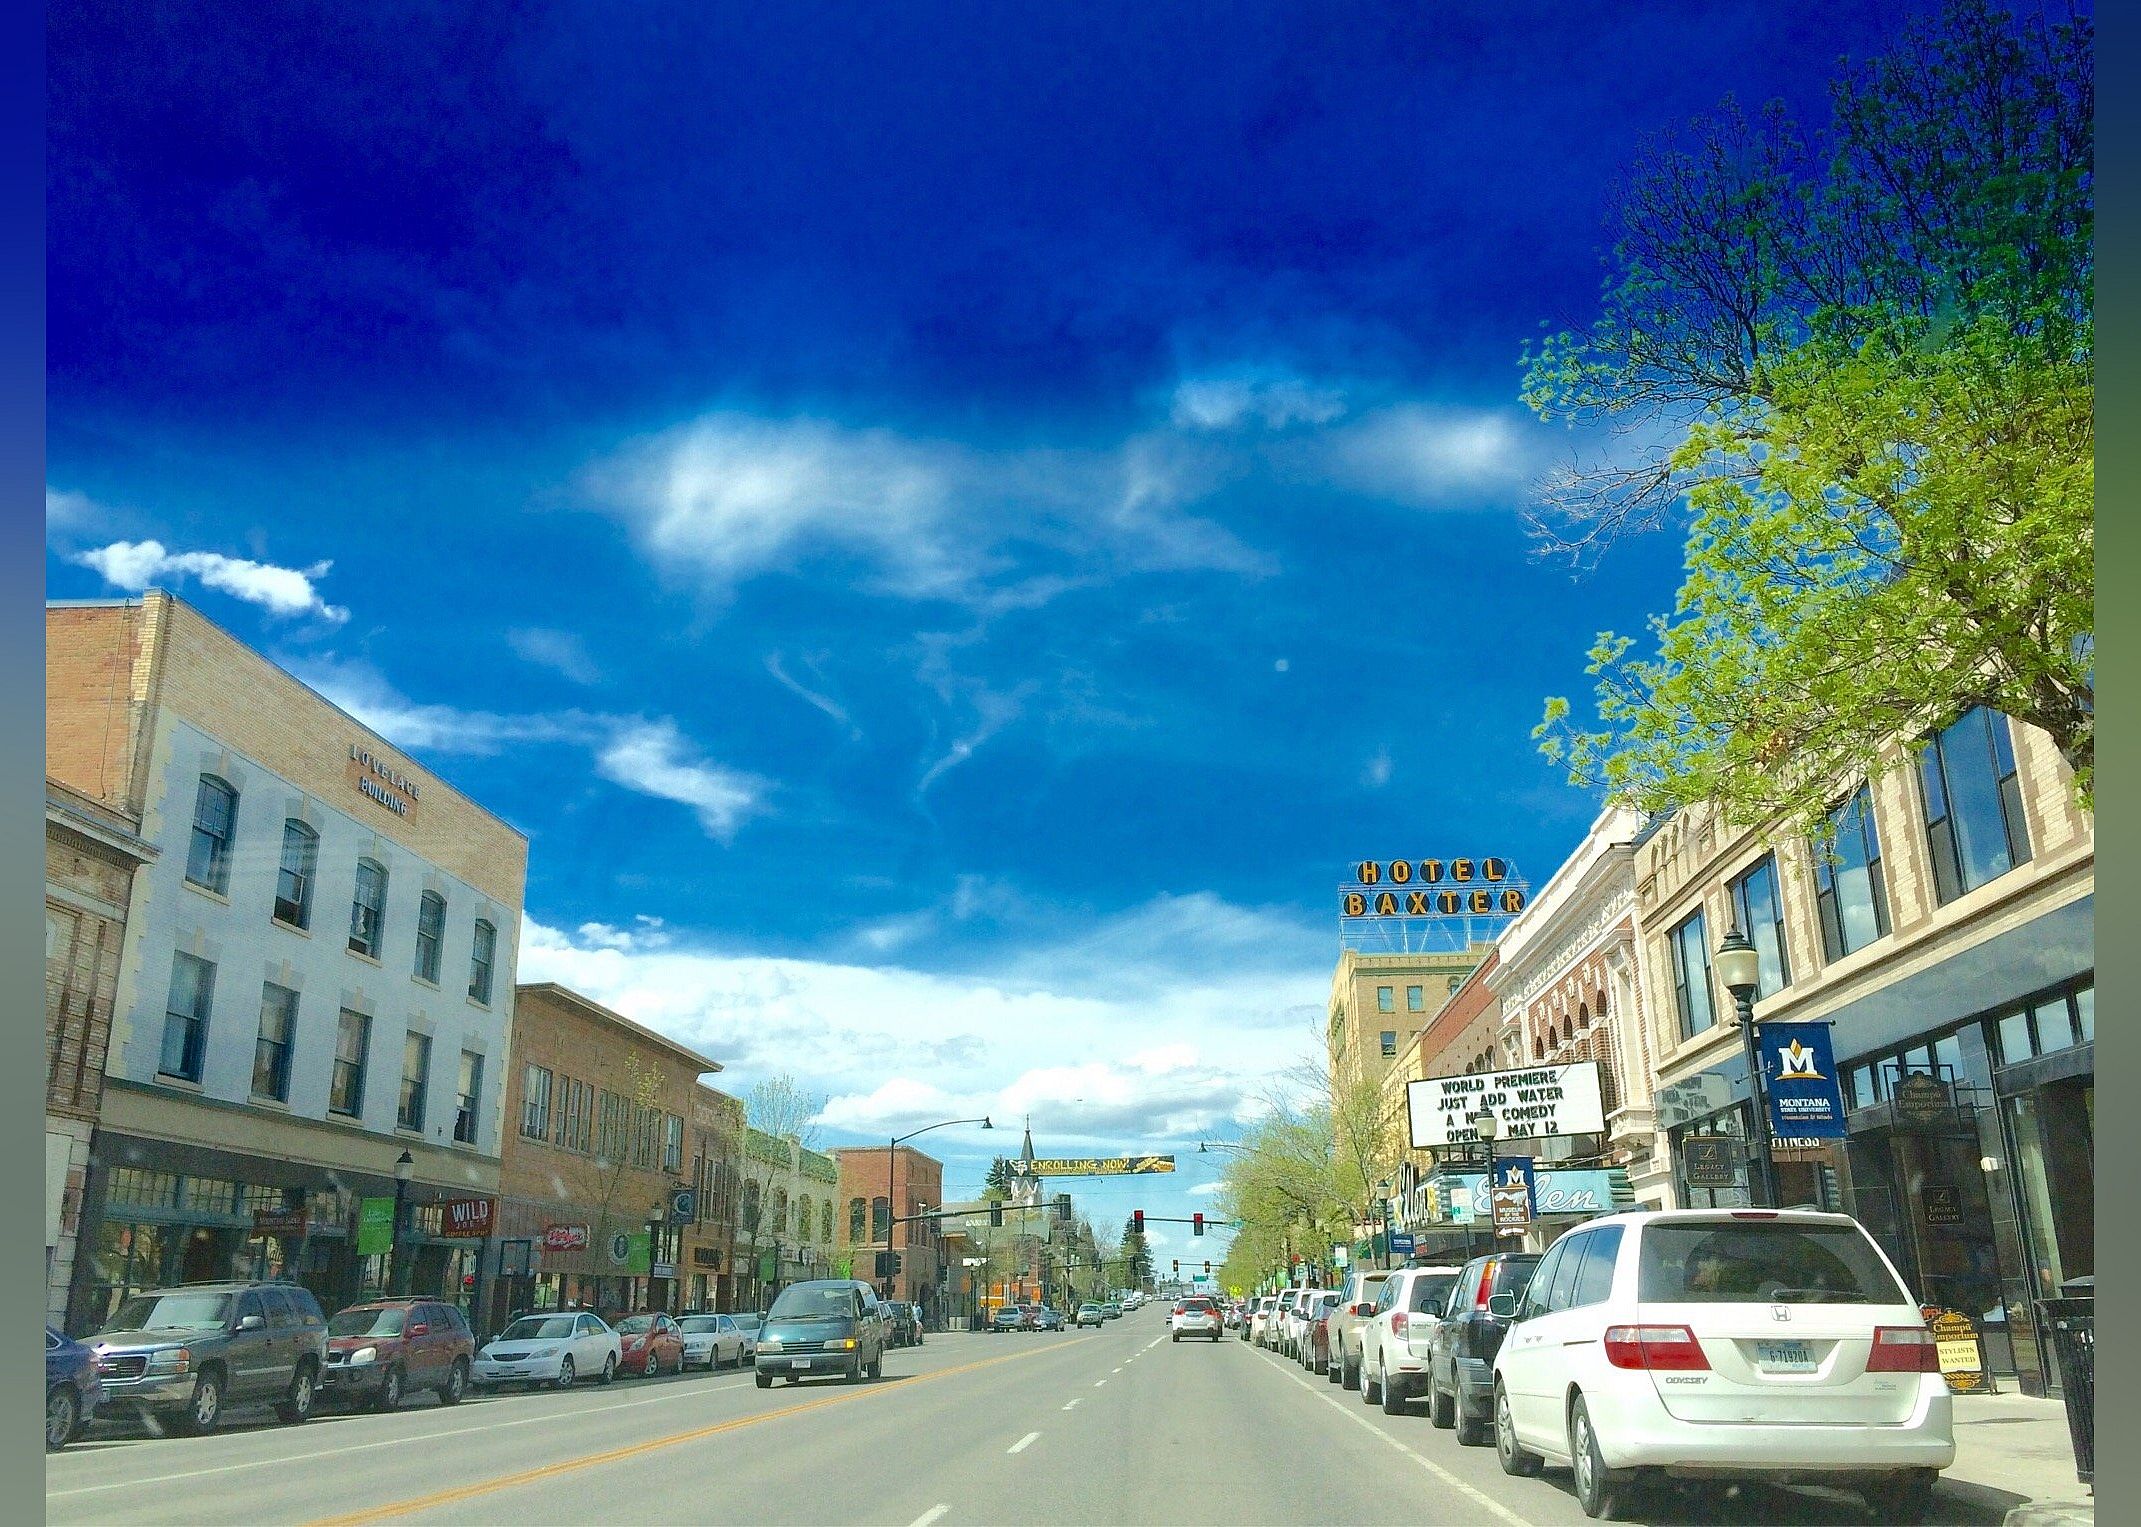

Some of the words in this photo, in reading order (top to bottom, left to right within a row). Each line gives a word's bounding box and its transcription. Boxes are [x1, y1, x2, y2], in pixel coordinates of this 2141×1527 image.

[360, 776, 408, 816] BUILDING
[1362, 858, 1503, 883] HOTEL
[1349, 889, 1521, 915] BAXTER
[1441, 1078, 1485, 1095] WORLD
[1494, 1070, 1558, 1088] PREMIERE
[1437, 1096, 1468, 1112] JUST
[1480, 1092, 1507, 1107] ADD
[1517, 1086, 1565, 1102] WATER
[1779, 1098, 1831, 1107] MONTANA
[1446, 1114, 1455, 1127] A
[1502, 1103, 1557, 1121] COMEDY
[1446, 1127, 1480, 1143] OPEN
[1508, 1121, 1536, 1138] MAY
[1545, 1121, 1559, 1135] 12
[1030, 1159, 1098, 1171] ENROLLING
[1473, 1172, 1601, 1213] Elen
[451, 1200, 488, 1223] WILD
[1940, 1346, 1975, 1355] STYLISTS
[1941, 1356, 1976, 1365] WANTED
[1665, 1376, 1709, 1385] ODYSSEY
